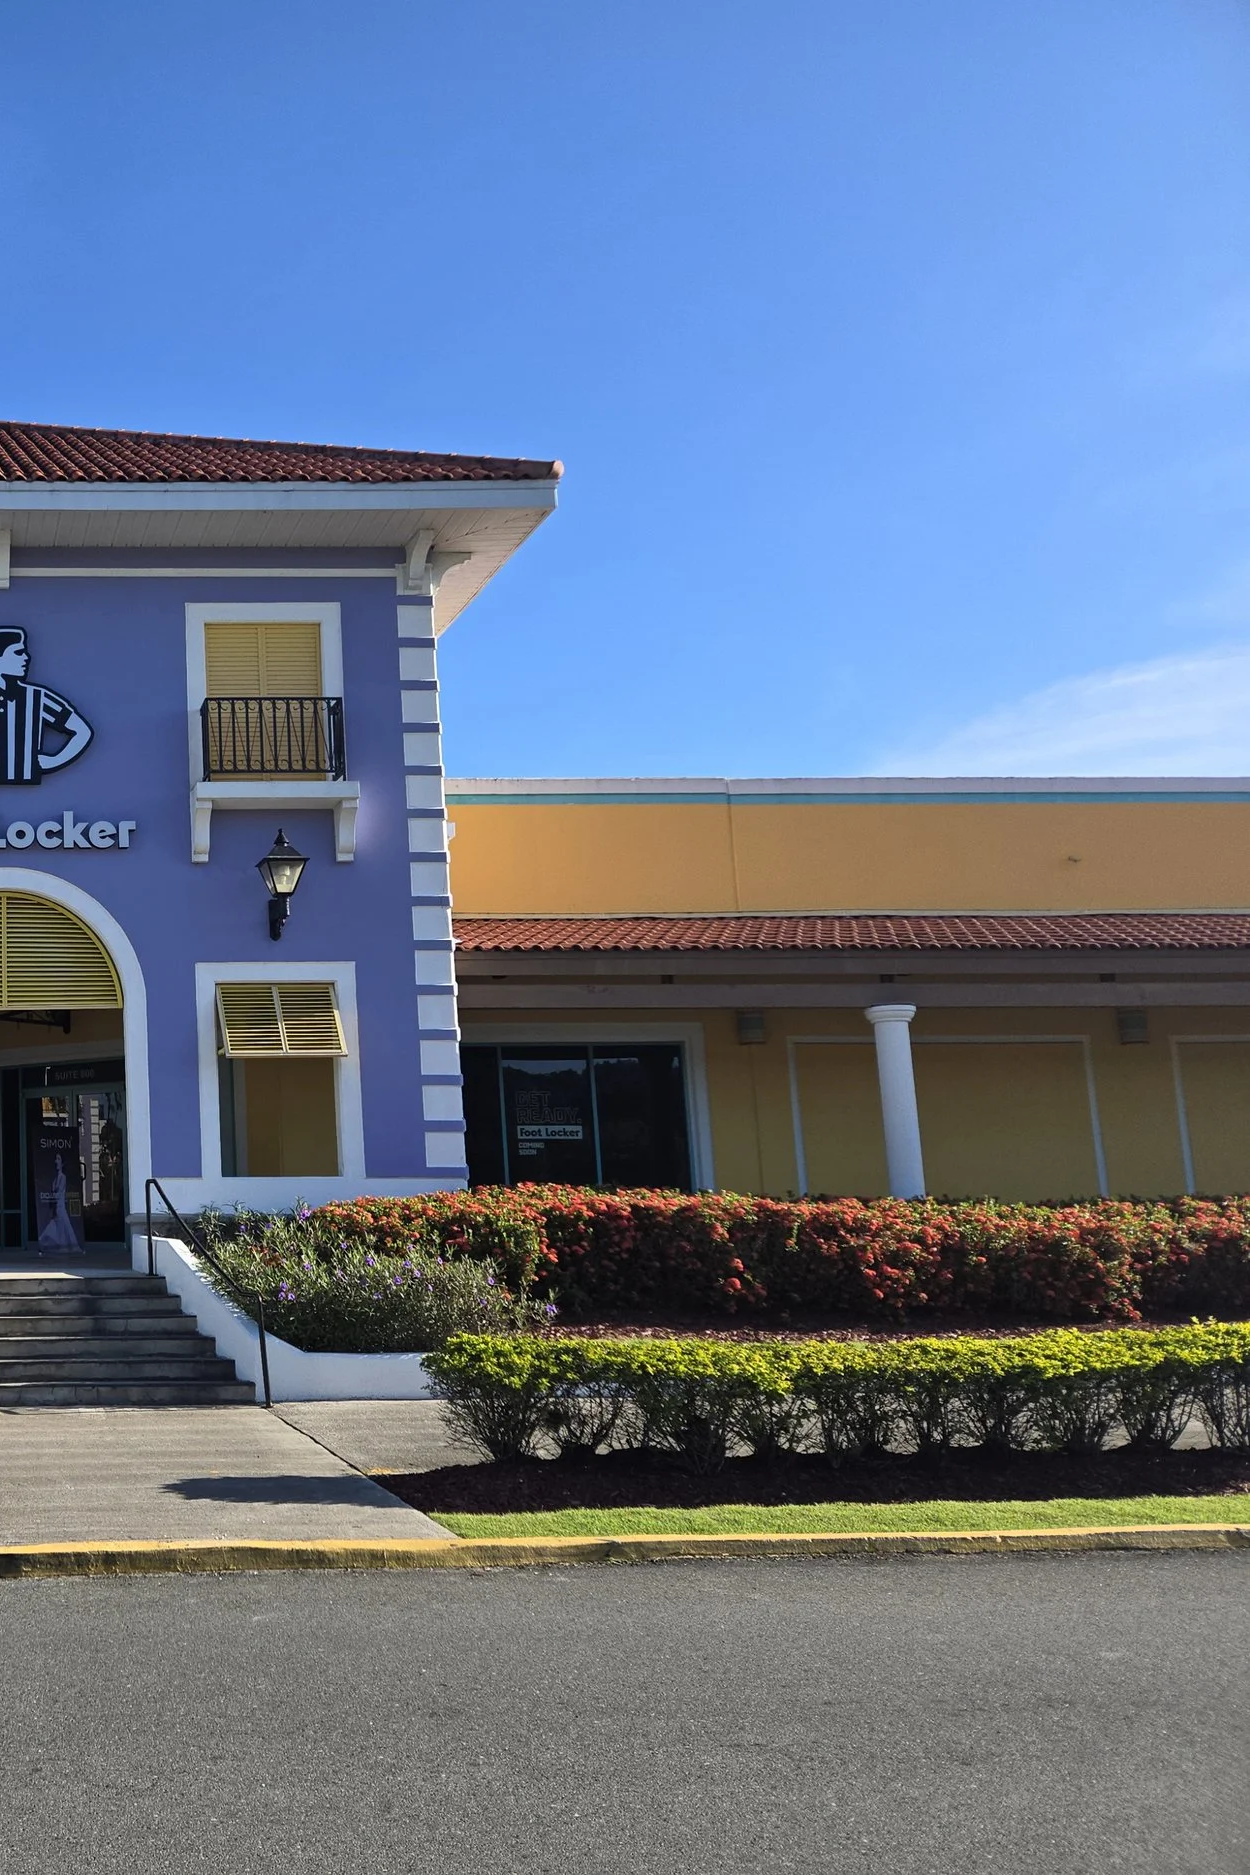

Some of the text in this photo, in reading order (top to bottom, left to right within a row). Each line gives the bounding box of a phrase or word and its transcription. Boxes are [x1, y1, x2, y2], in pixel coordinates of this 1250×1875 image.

[519, 1127, 580, 1137] Foot Locker
[40, 1138, 72, 1149] SIMON
